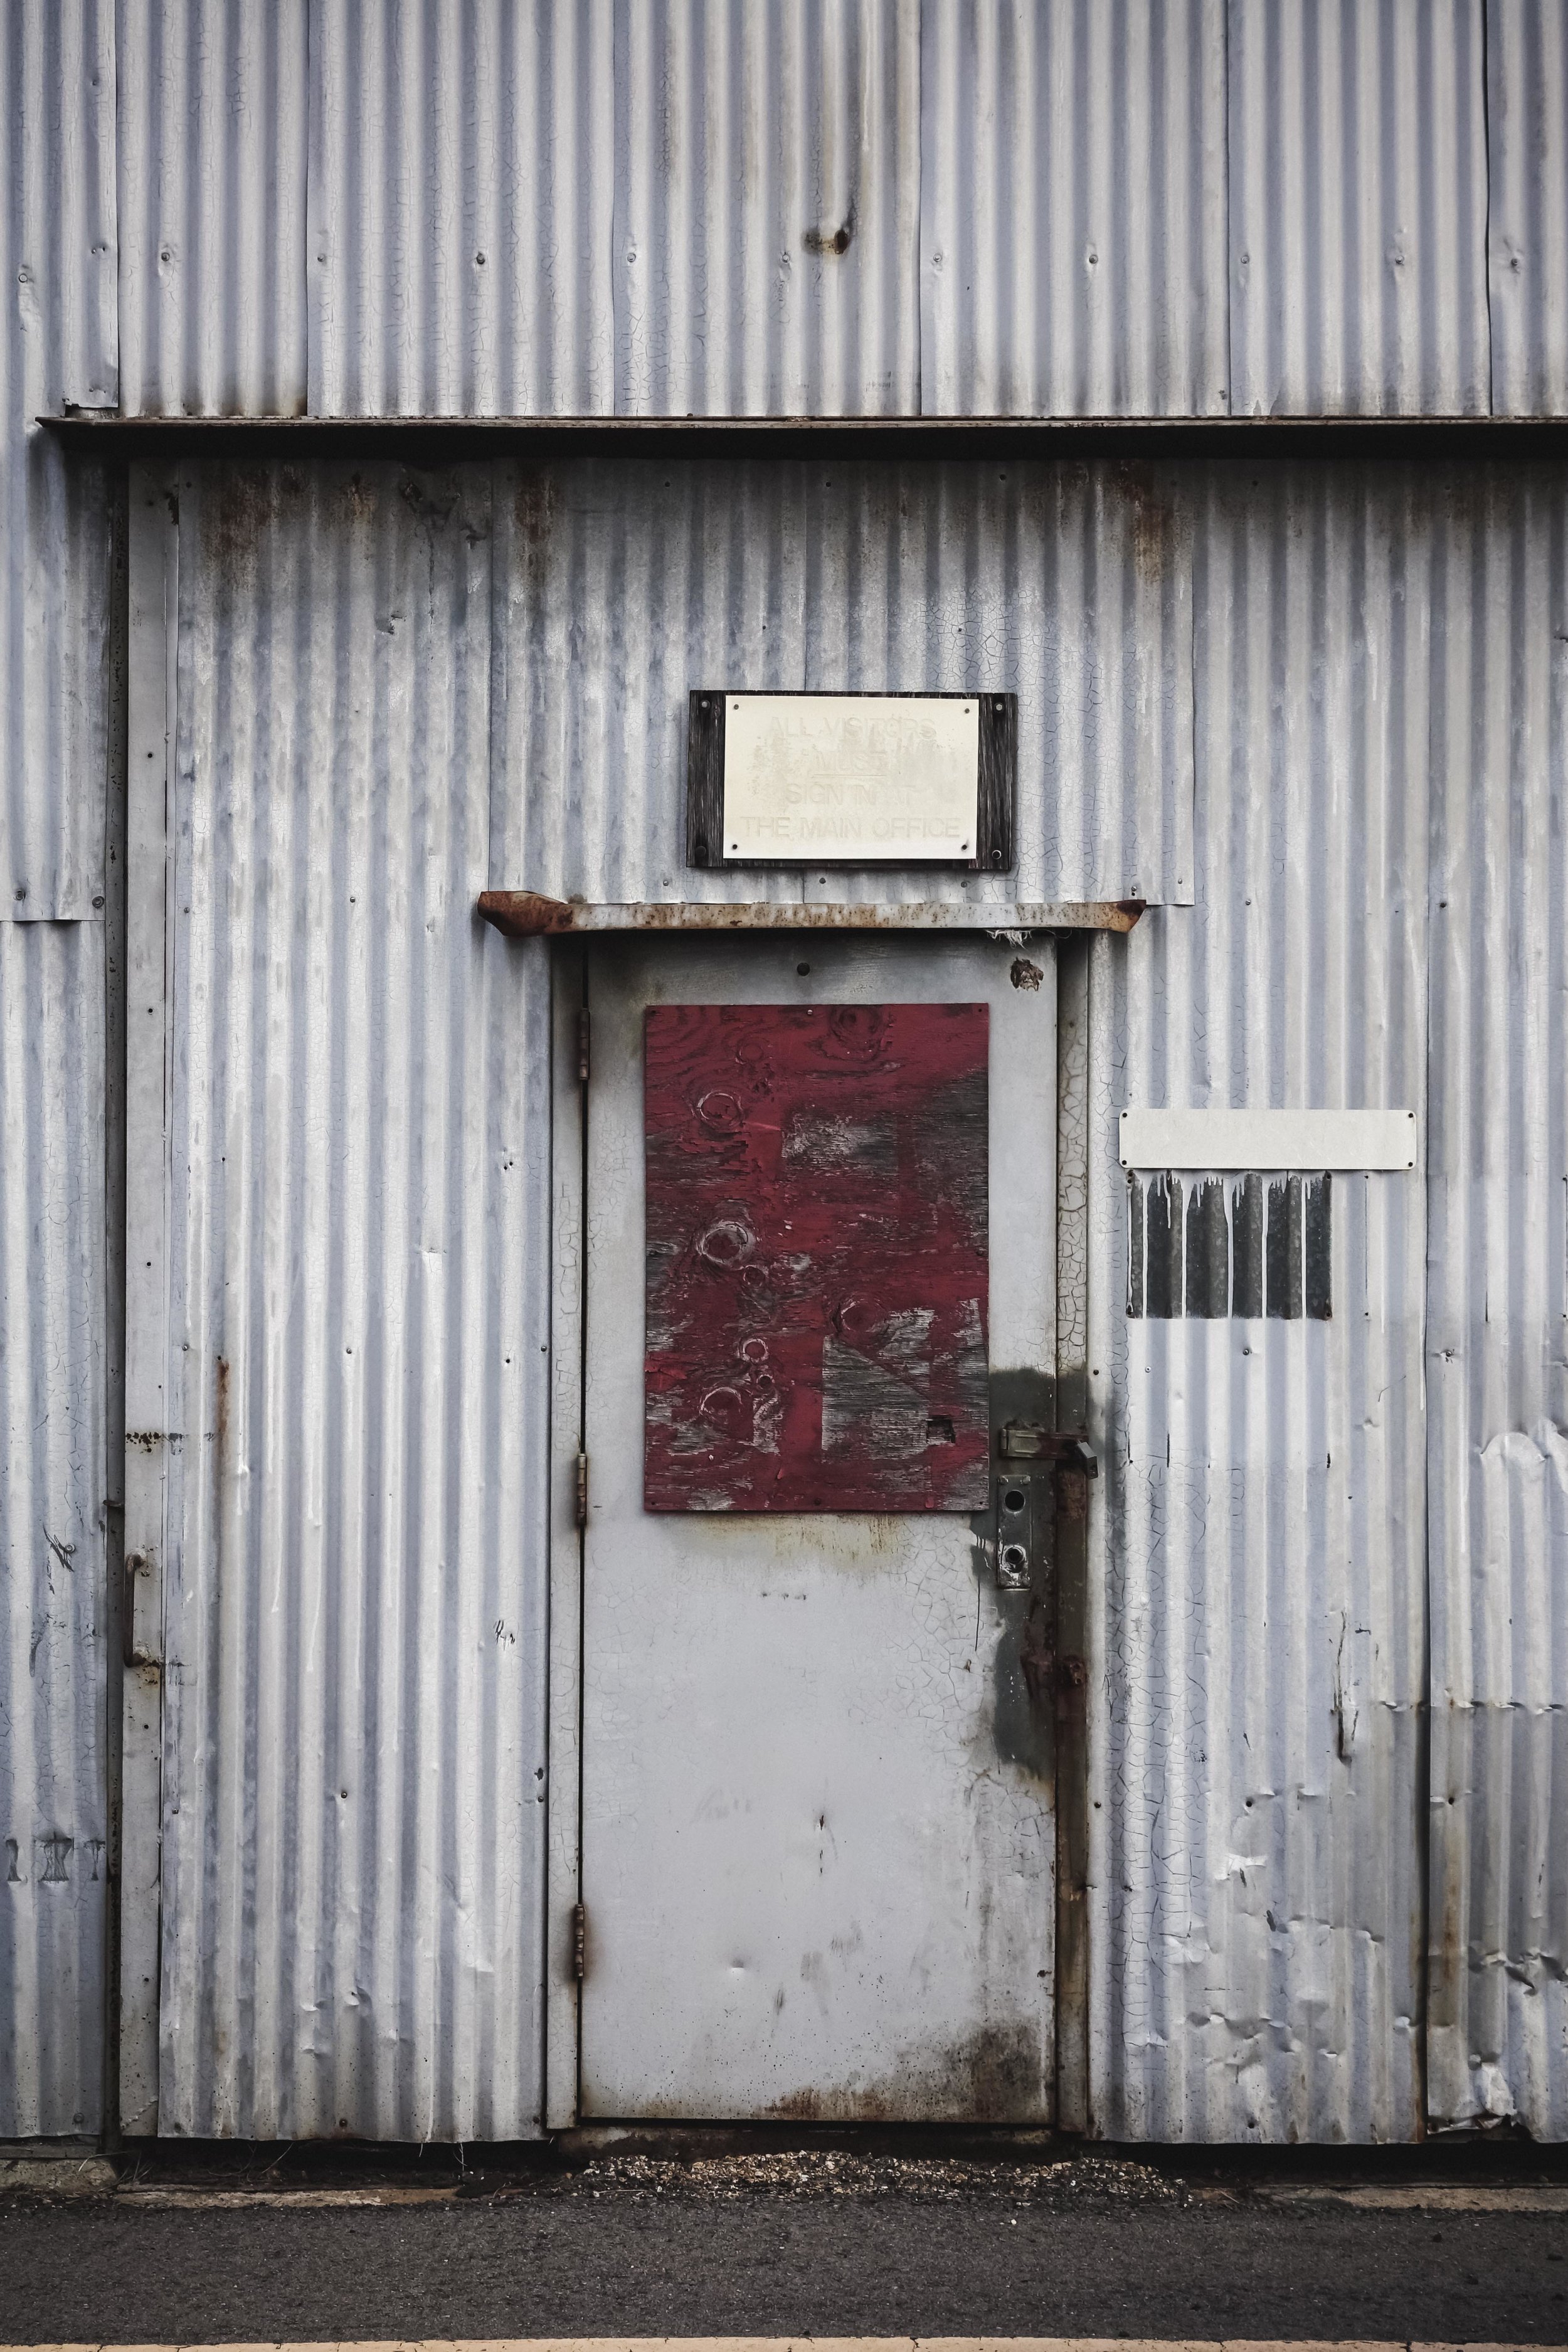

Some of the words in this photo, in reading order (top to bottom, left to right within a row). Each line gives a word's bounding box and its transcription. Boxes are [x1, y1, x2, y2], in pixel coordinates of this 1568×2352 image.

[769, 716, 813, 738] ALL
[822, 716, 937, 739] VISITORS
[814, 750, 887, 772] MUST
[785, 781, 844, 805] SIGN
[739, 816, 790, 838] THE
[800, 817, 862, 839] MAIN
[871, 817, 961, 839] OFFICE
